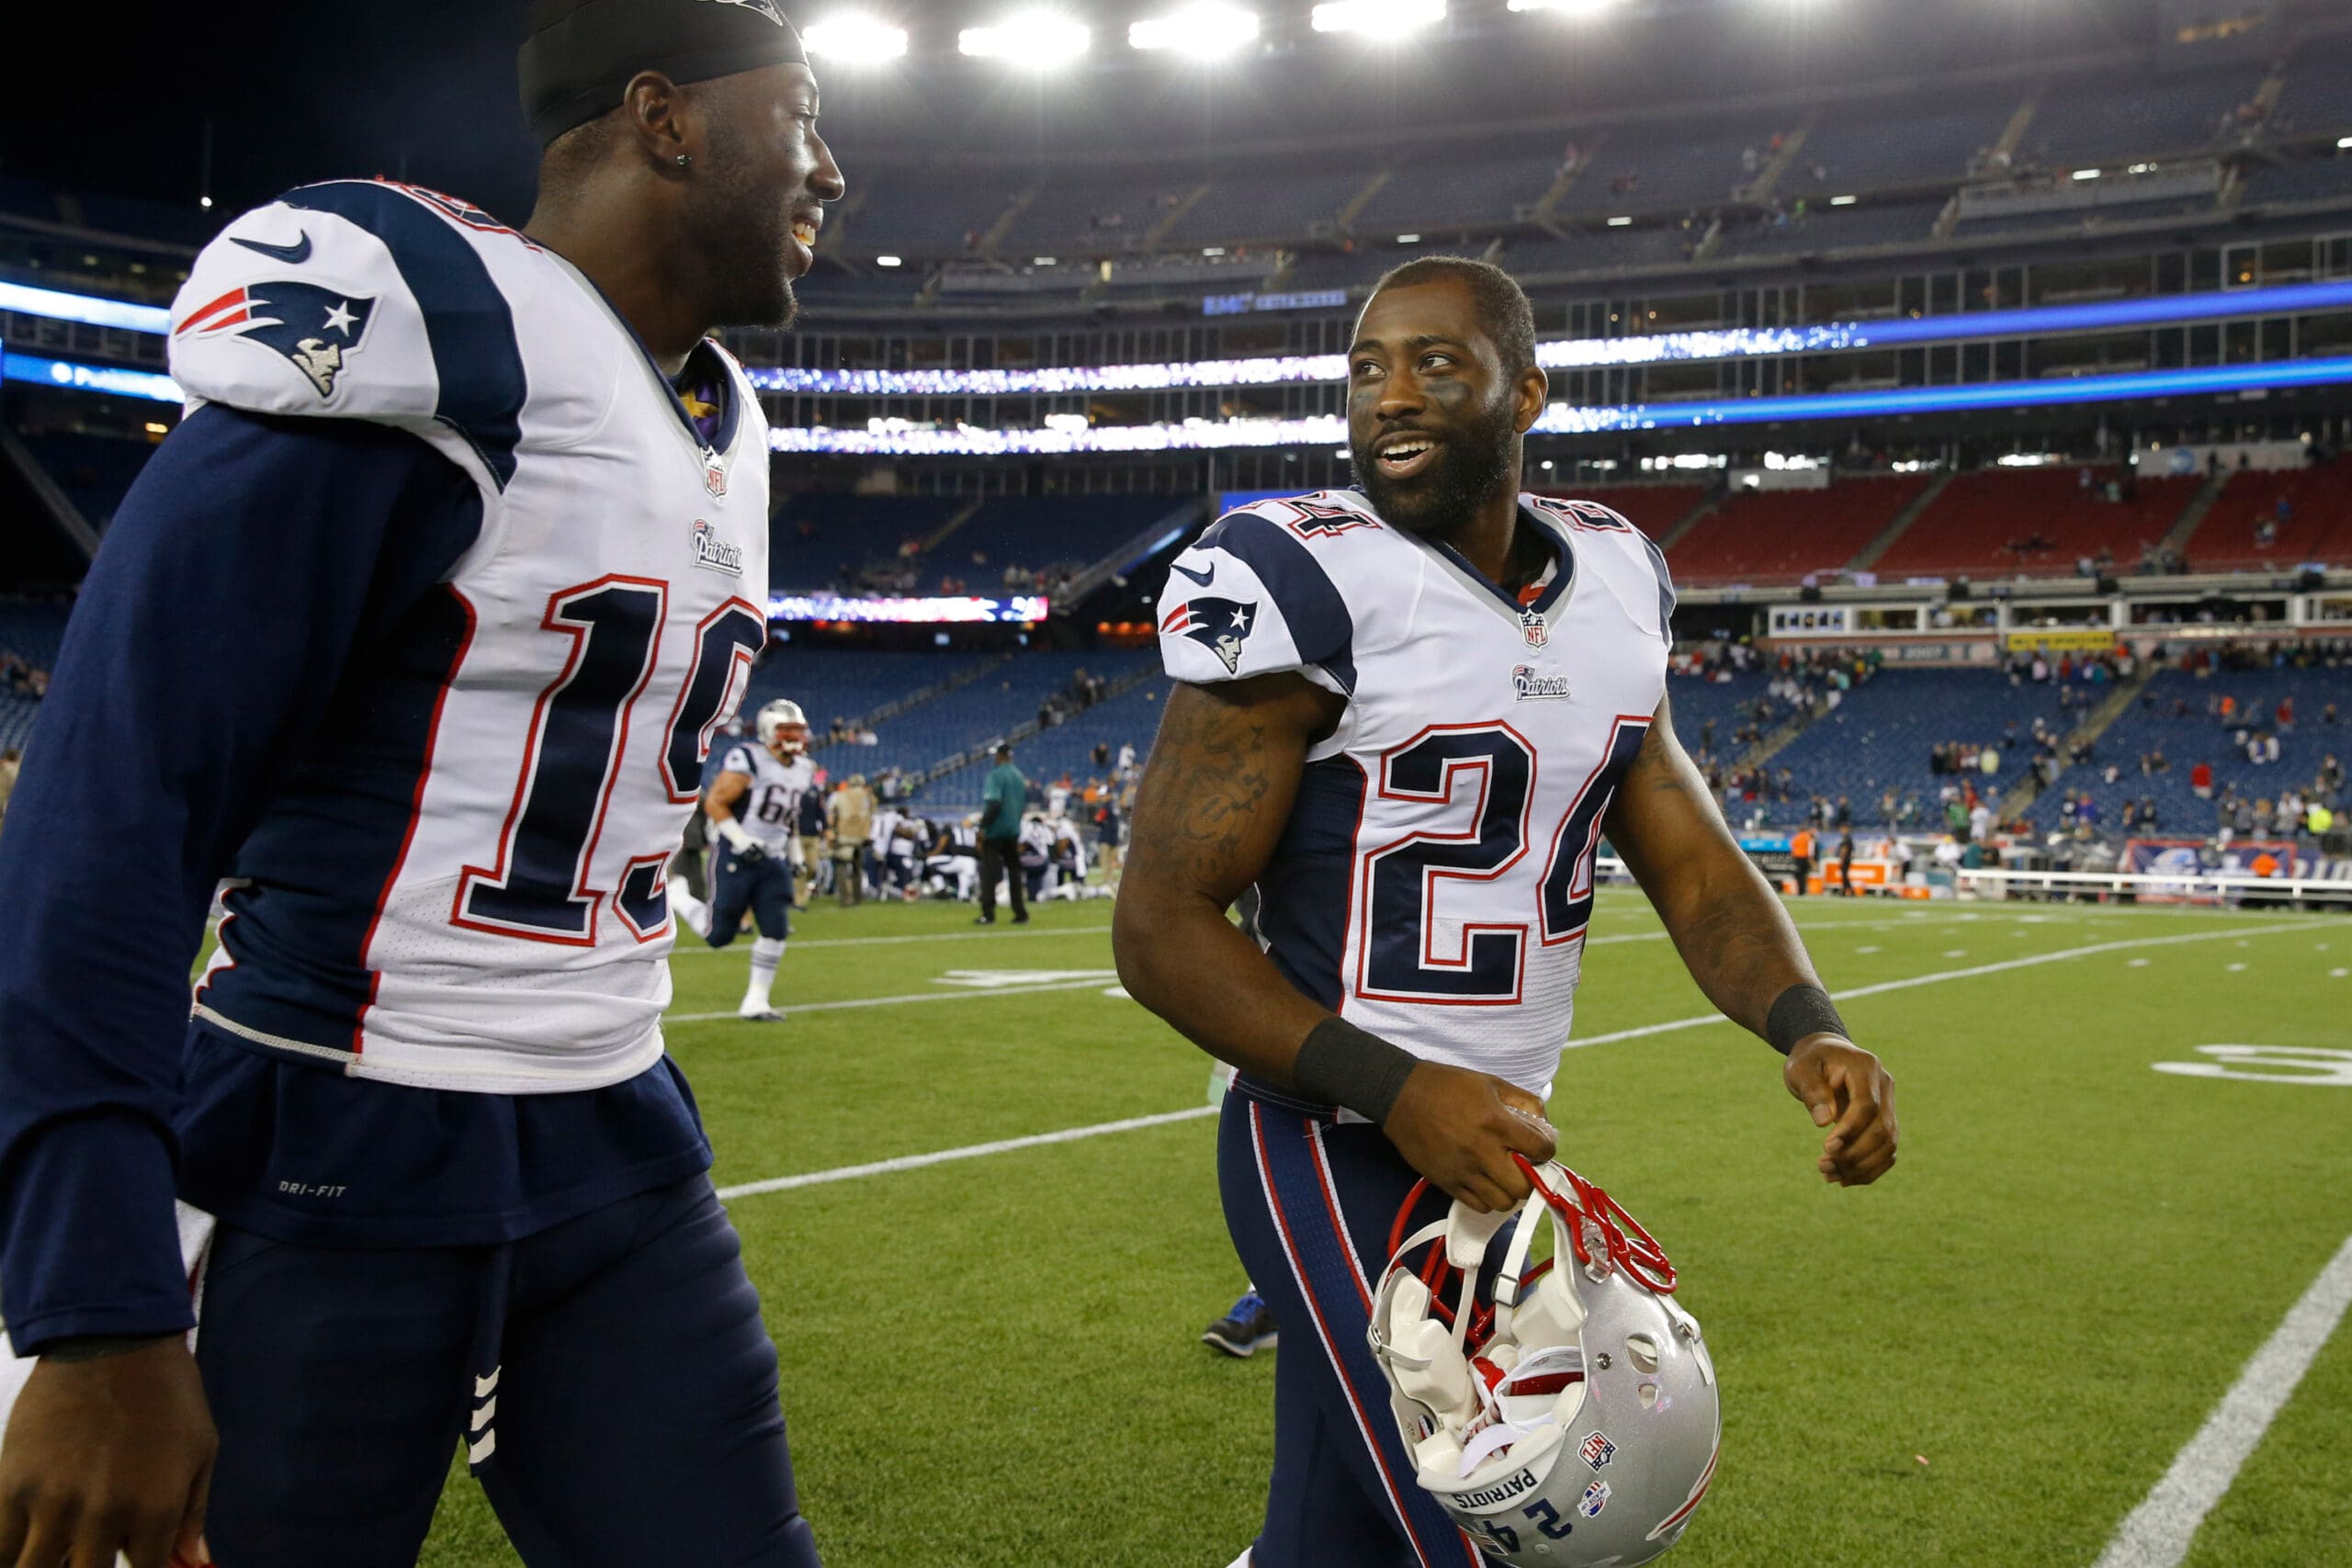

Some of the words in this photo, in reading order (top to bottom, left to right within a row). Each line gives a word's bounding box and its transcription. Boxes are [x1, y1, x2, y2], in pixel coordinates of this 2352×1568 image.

[707, 469, 727, 491] NFL
[1525, 626, 1546, 643] NFL
[1513, 675, 1568, 700] Patriots
[1355, 716, 1653, 1005] 24
[278, 1180, 346, 1197] DRI-FIT
[1582, 1435, 1606, 1460] NFL
[1451, 1468, 1538, 1508] PATRIOTS
[1483, 1498, 1573, 1552] 24
